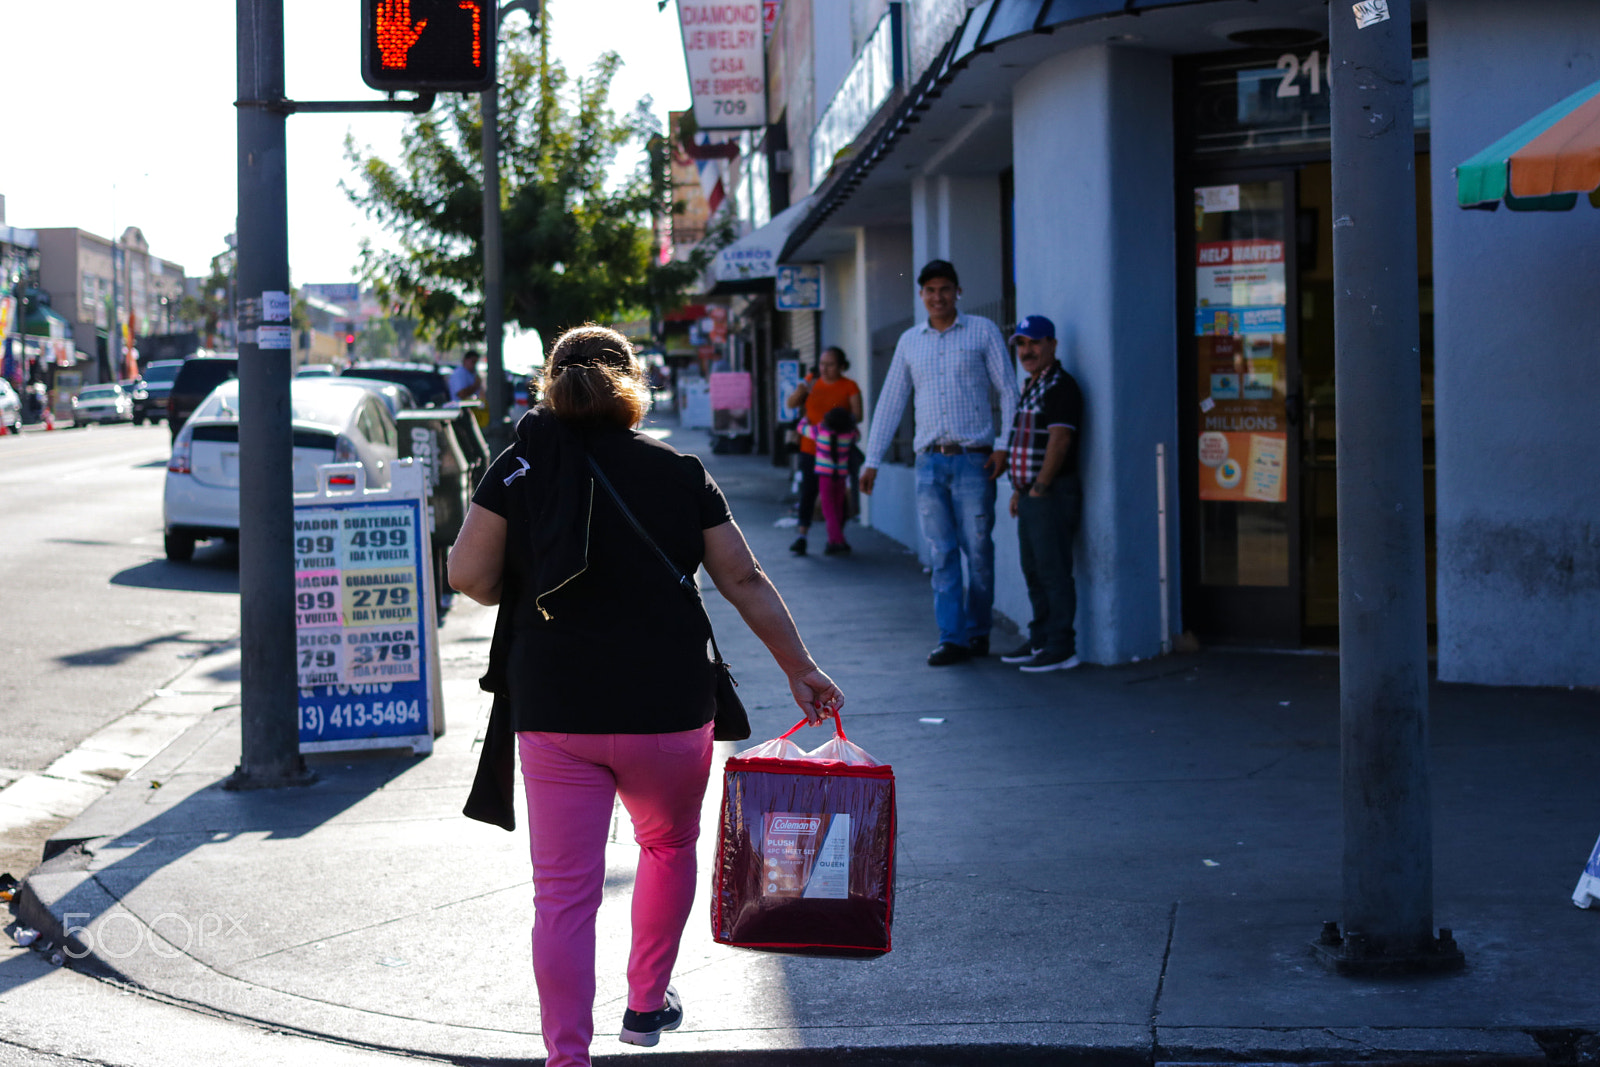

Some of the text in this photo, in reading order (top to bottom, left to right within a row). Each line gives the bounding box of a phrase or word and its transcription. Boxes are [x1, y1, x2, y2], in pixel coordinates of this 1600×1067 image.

[684, 5, 757, 25] DIAMOND
[688, 30, 755, 51] JEWELRY
[710, 58, 745, 74] CASA
[1276, 50, 1331, 98] 21
[696, 79, 709, 95] DE
[713, 100, 747, 115] 709
[1200, 245, 1282, 263] HELP WANTED
[1206, 416, 1278, 430] MILLIONS
[344, 516, 411, 529] GUATEMALA
[297, 536, 334, 554] 99
[350, 530, 407, 548] 499
[303, 557, 336, 568] VUELTA
[350, 549, 409, 562] IDA Y VUELTA
[346, 573, 414, 587] GUADALAJARA
[298, 592, 335, 610] 99
[353, 587, 410, 608] 279
[305, 613, 338, 624] VUELTA
[353, 607, 412, 621] IDA Y VUELTA
[348, 630, 415, 644] OAXACA
[299, 649, 335, 668] 79
[354, 644, 411, 663] 379
[306, 673, 339, 684] VUELTA
[354, 664, 414, 677] IDA Y VUELTA
[330, 700, 420, 728] 413-5494
[775, 819, 809, 830] Coleman
